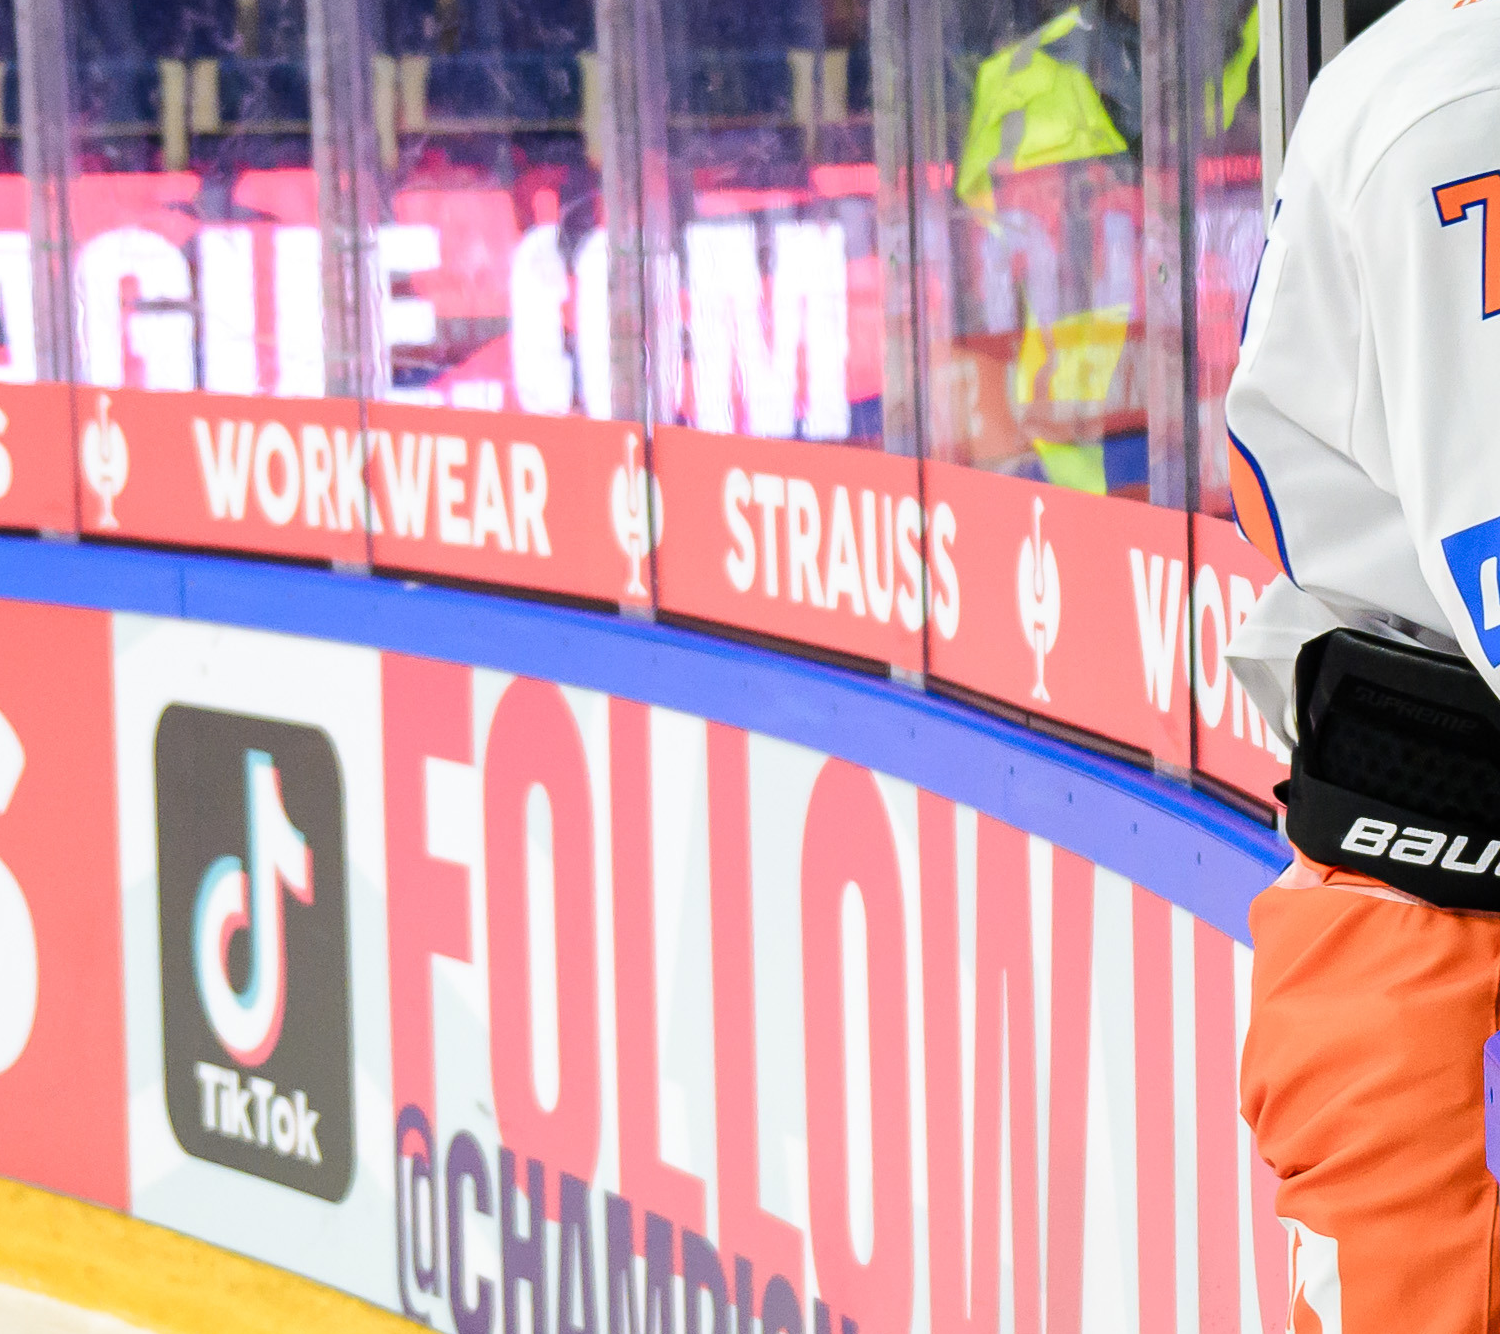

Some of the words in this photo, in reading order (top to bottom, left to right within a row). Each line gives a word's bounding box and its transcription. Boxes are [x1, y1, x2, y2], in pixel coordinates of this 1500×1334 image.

[191, 415, 553, 558] WORKWEAR
[721, 468, 961, 641] STRAUSS
[196, 1062, 323, 1166] TikTok
